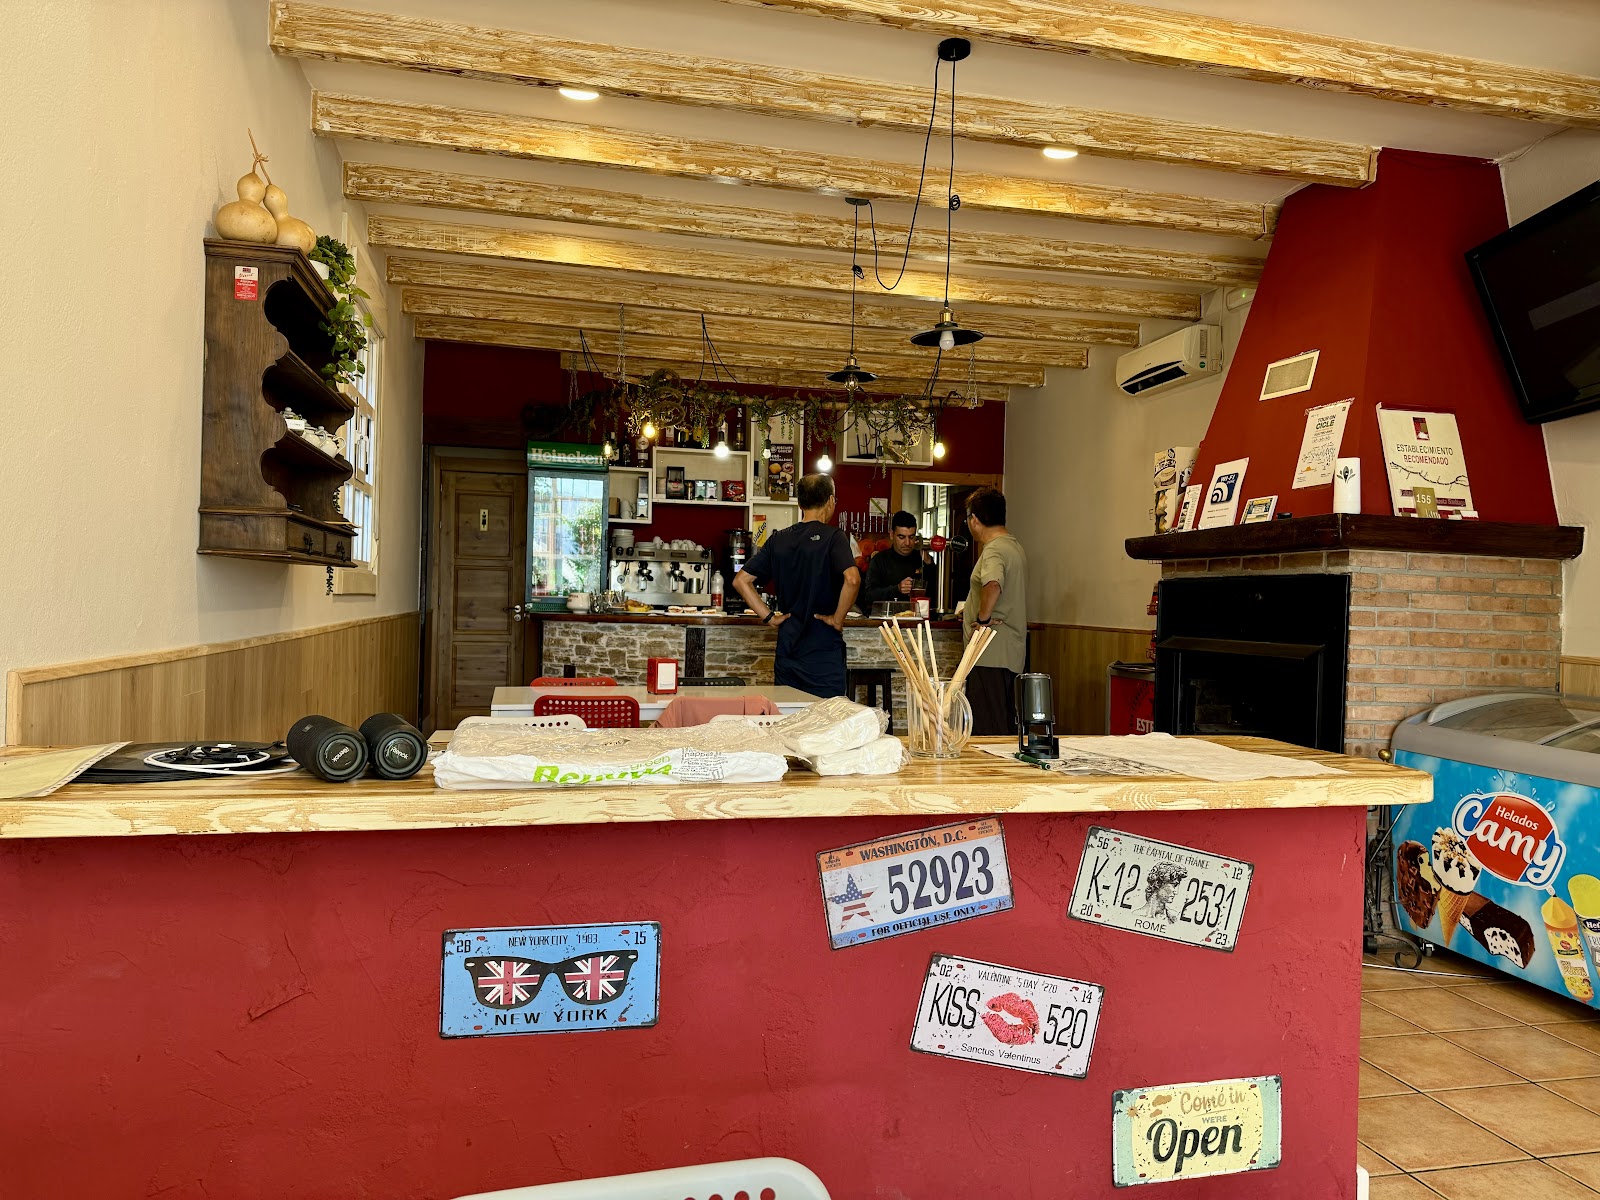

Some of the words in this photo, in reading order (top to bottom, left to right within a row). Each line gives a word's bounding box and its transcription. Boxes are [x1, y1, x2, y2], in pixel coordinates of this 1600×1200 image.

[531, 448, 605, 465] Heineken
[1396, 444, 1453, 456] ESTABLECIMIENTO
[1403, 454, 1449, 466] RECOMENDADO
[1416, 493, 1432, 504] 155
[753, 521, 767, 544] olaCao
[630, 755, 671, 770] green
[1495, 805, 1539, 831] Helados
[859, 835, 941, 861] WASHINGTON,
[943, 830, 967, 844] D.C.
[1097, 837, 1110, 849] 56
[1454, 799, 1561, 884] Camy
[1133, 844, 1146, 855] THE
[1146, 846, 1173, 862] CAPITAL
[1175, 853, 1184, 862] OF
[1185, 856, 1210, 869] FRANCE
[887, 846, 994, 914] 52923
[1232, 867, 1243, 880] 12
[1086, 855, 1141, 910] K-12
[1179, 877, 1237, 931] 2531
[1080, 903, 1093, 917] 20
[872, 926, 890, 937] FOR
[893, 918, 931, 932] OFFICIAL
[934, 912, 951, 925] USE
[953, 905, 977, 919] ONLY
[1134, 918, 1168, 934] ROME
[508, 936, 527, 946] NEW
[528, 935, 550, 946] YORK
[551, 934, 568, 945] CITY
[634, 931, 646, 945] 15
[1214, 932, 1227, 946] 23
[939, 964, 952, 978] 02
[978, 969, 1012, 985] VALENTINE
[1081, 990, 1093, 1004] 14
[494, 1012, 541, 1026] NEW
[553, 1008, 607, 1023] YORK
[928, 983, 981, 1030] KISS
[1043, 1003, 1088, 1049] 520
[961, 1042, 995, 1057] Sanctus
[998, 1049, 1041, 1065] Valentinus
[1180, 1091, 1227, 1114] Come
[1229, 1089, 1246, 1105] in
[1202, 1115, 1227, 1124] WE'RE
[1146, 1118, 1243, 1175] Open
